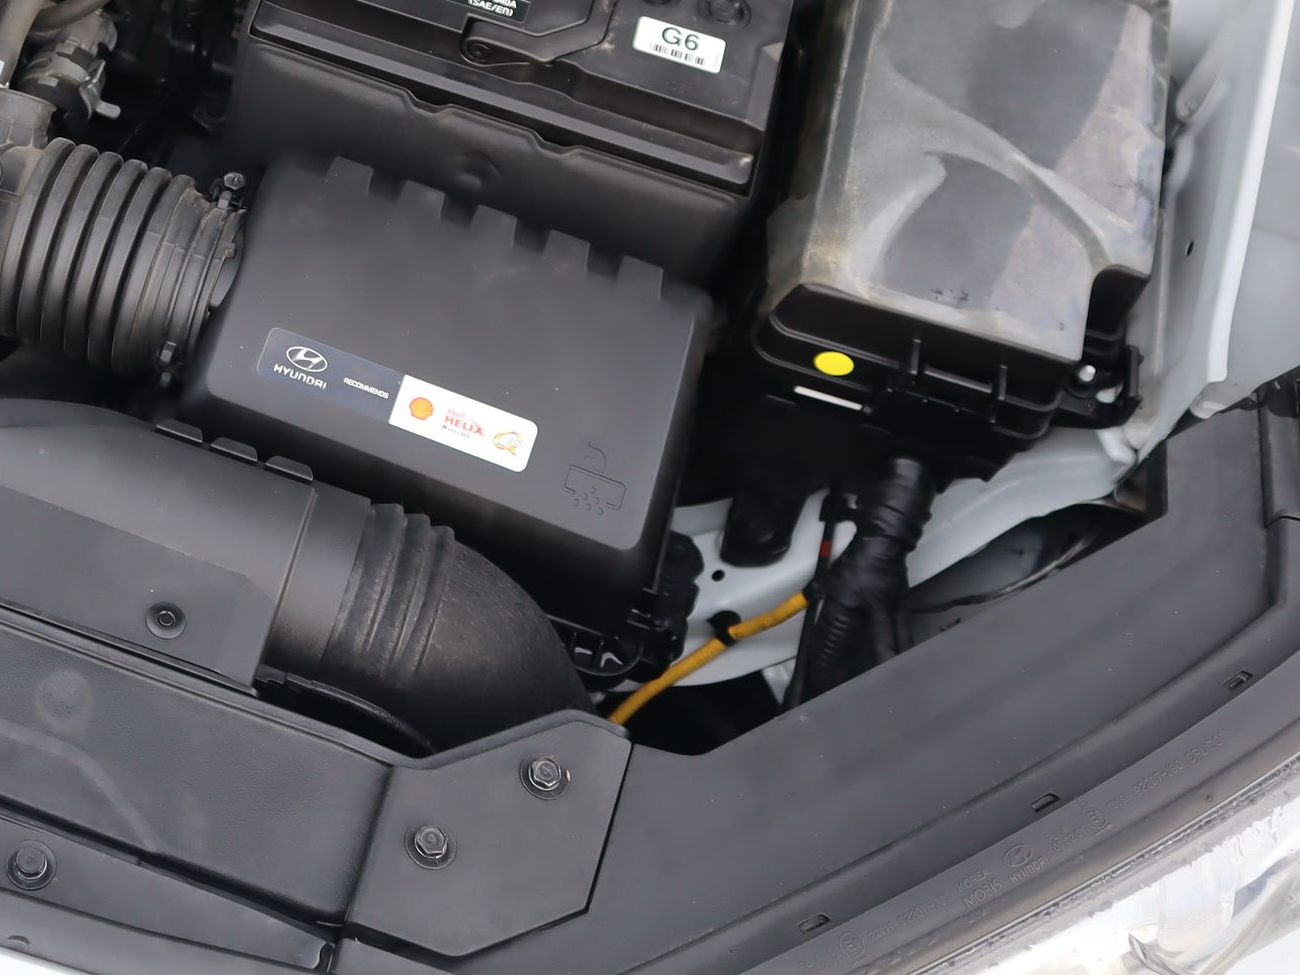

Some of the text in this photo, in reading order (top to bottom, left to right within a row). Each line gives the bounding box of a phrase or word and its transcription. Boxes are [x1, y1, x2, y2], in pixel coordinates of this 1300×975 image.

[662, 26, 700, 51] G6
[273, 363, 327, 390] HYUNDAI
[343, 377, 390, 399] RECOMMENDS
[444, 415, 484, 436] HELIX
[1010, 856, 1051, 884] HYUNDAI
[963, 879, 1003, 906] MOBIS
